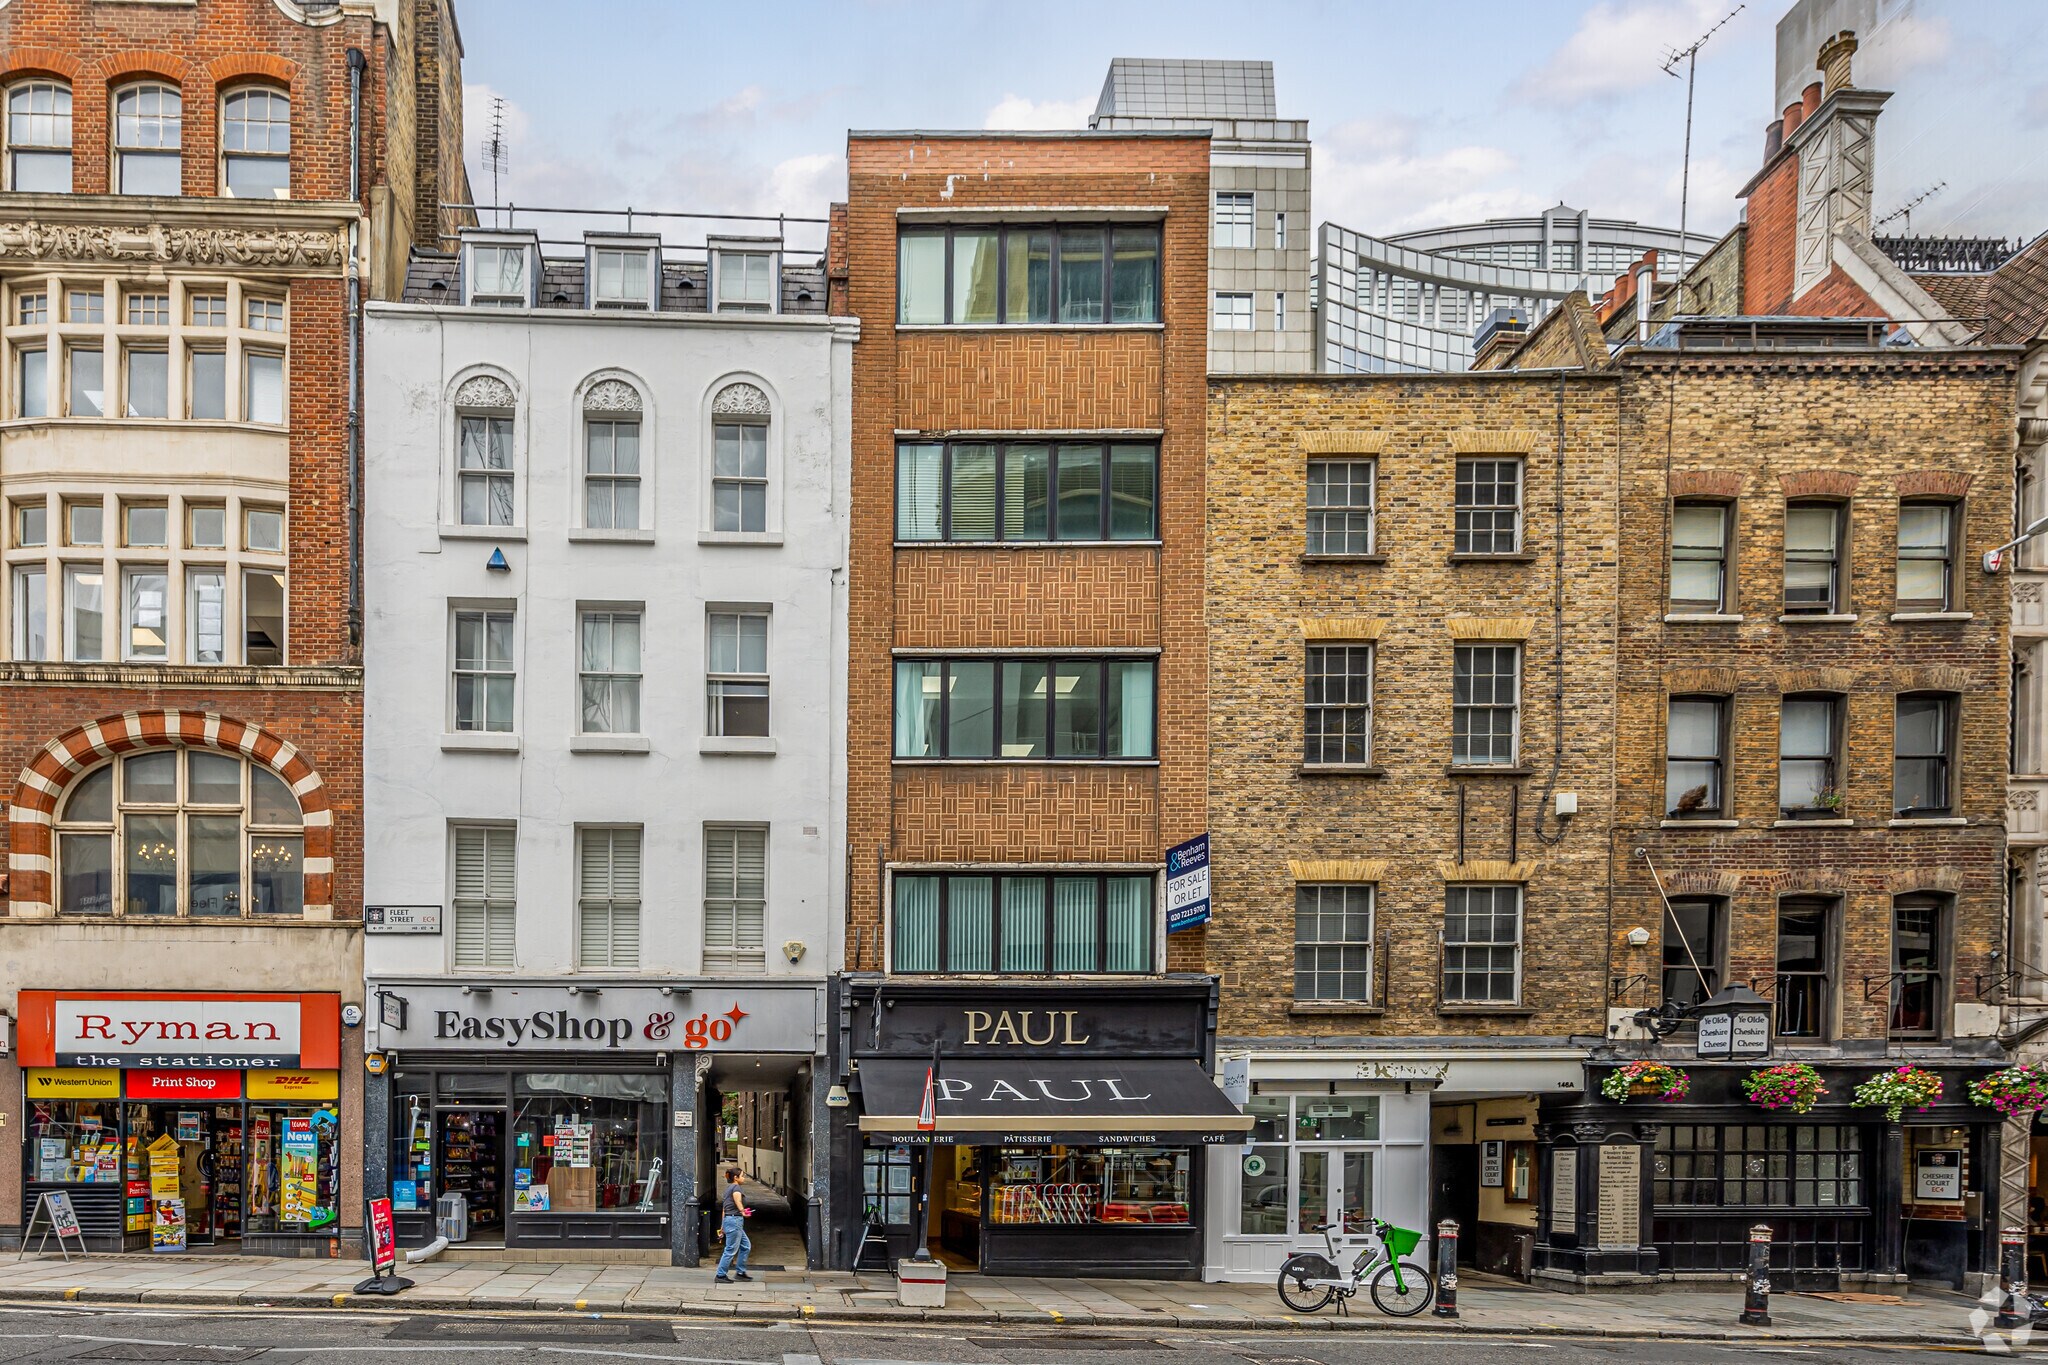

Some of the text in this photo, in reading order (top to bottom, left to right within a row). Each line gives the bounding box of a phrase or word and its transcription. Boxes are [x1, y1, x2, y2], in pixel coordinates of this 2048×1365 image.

[1177, 842, 1205, 860] Benham
[1170, 851, 1205, 872] & Reeves
[1169, 869, 1207, 893] FOR SALE
[1174, 886, 1202, 905] OR LET
[1171, 913, 1180, 921] 020
[75, 1015, 281, 1046] Ryman
[433, 1009, 732, 1049] EasyShop & go
[963, 1010, 1090, 1046] PAUL
[1701, 1028, 1728, 1036] Cheshire
[1734, 1028, 1765, 1036] Cheshire
[1703, 1040, 1727, 1048] Cheese
[76, 1055, 281, 1067] the stationer
[54, 1078, 113, 1086] Western Union
[152, 1076, 216, 1089] Print Shop
[274, 1076, 312, 1085] DHL
[937, 1078, 1152, 1101] PAUL
[287, 1132, 313, 1142] New
[892, 1135, 954, 1143] BOULANERIE
[1004, 1134, 1052, 1143] PÂTISSERIE
[1202, 1133, 1225, 1142] CAFÉ
